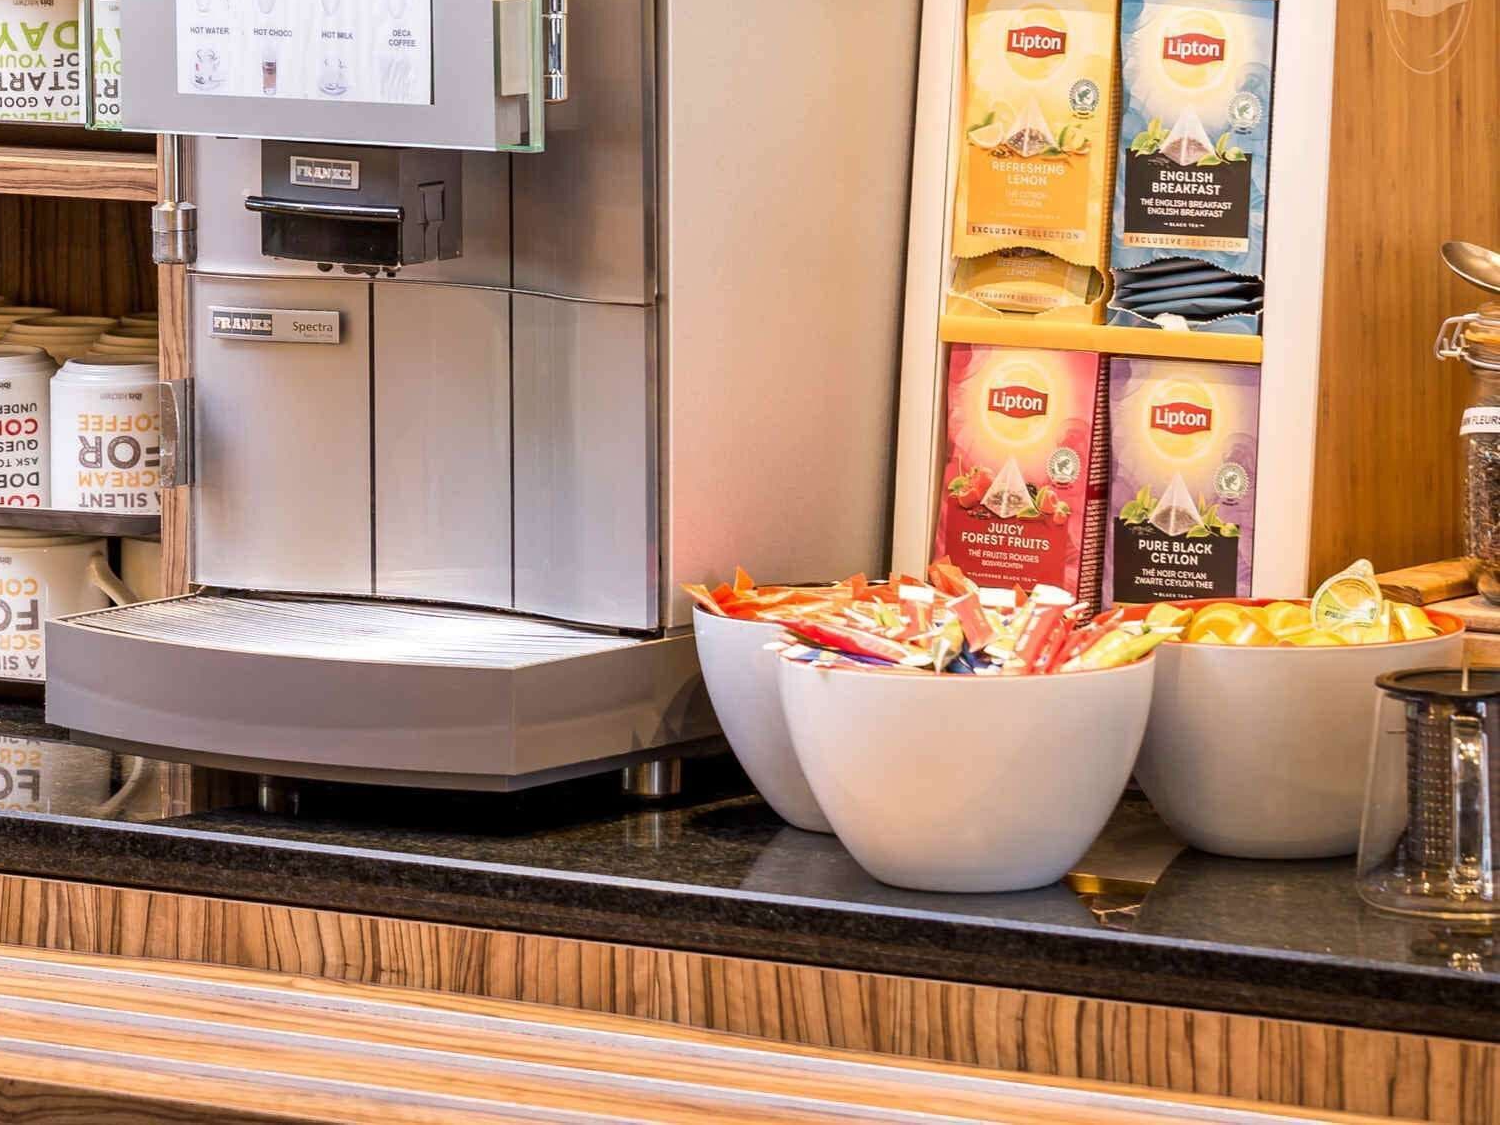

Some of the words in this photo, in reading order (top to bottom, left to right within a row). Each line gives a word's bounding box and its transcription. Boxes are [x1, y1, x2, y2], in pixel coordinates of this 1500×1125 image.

[190, 26, 205, 34] HOT
[206, 27, 229, 35] WATER
[1011, 32, 1062, 51] Lipton
[1167, 39, 1220, 59] Lipton
[53, 53, 80, 68] OF
[44, 96, 55, 106] A
[296, 165, 352, 180] FRANKE
[991, 161, 1065, 175] REFRESHING
[1008, 175, 1048, 186] LEMON
[1160, 170, 1213, 183] ENGLISH
[1152, 182, 1221, 195] BREAKFAST
[1155, 198, 1187, 208] ENGLISH
[1188, 200, 1232, 210] BREAKFAST
[1147, 207, 1179, 216] ENGLISH
[1180, 208, 1224, 218] BREAKFAST
[971, 226, 1023, 236] EXCLUSIVE
[1128, 235, 1181, 245] EXCLUSIVE
[214, 316, 272, 331] FRANKE
[293, 321, 333, 334] Spectra
[993, 392, 1043, 411] Lipton
[1156, 408, 1207, 428] Lipton
[16, 457, 38, 467] ASK
[79, 493, 148, 508] SILENT
[988, 523, 1024, 535] JUICY
[962, 531, 1005, 545] FOREST
[1008, 536, 1050, 551] FRUITS
[1138, 539, 1169, 552] PURE
[1172, 541, 1213, 554] BLACK
[982, 550, 1009, 561] FRUITS
[1009, 554, 1040, 563] ROUGES
[1150, 552, 1199, 565] CEYLON
[1157, 569, 1177, 578] NOIR
[1177, 571, 1207, 580] CEYLAN
[1134, 575, 1164, 586] ZWARTE
[1164, 578, 1195, 588] CEYLON
[1195, 580, 1214, 589] THEE
